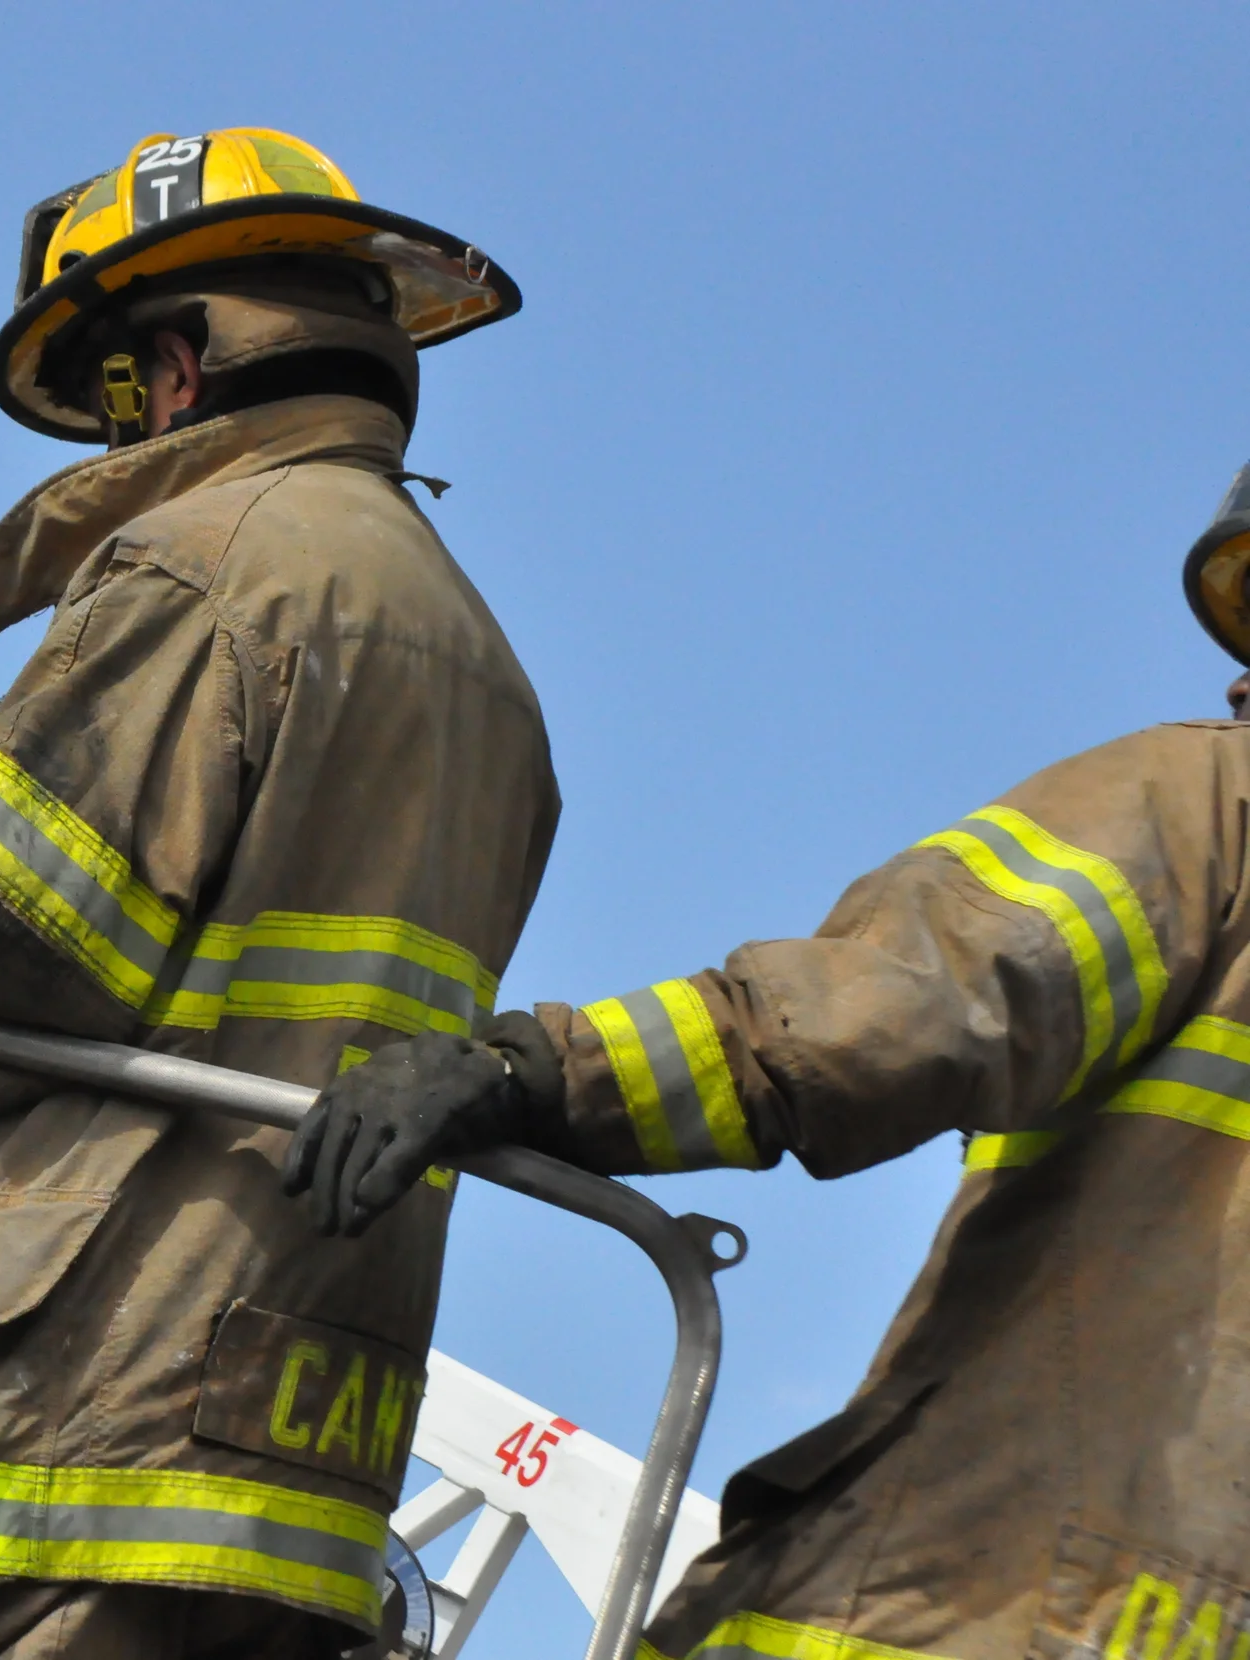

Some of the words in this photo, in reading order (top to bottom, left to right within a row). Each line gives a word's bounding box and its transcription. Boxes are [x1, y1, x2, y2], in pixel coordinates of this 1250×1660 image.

[135, 135, 203, 173] 25
[150, 175, 179, 221] T
[494, 1421, 561, 1488] 45
